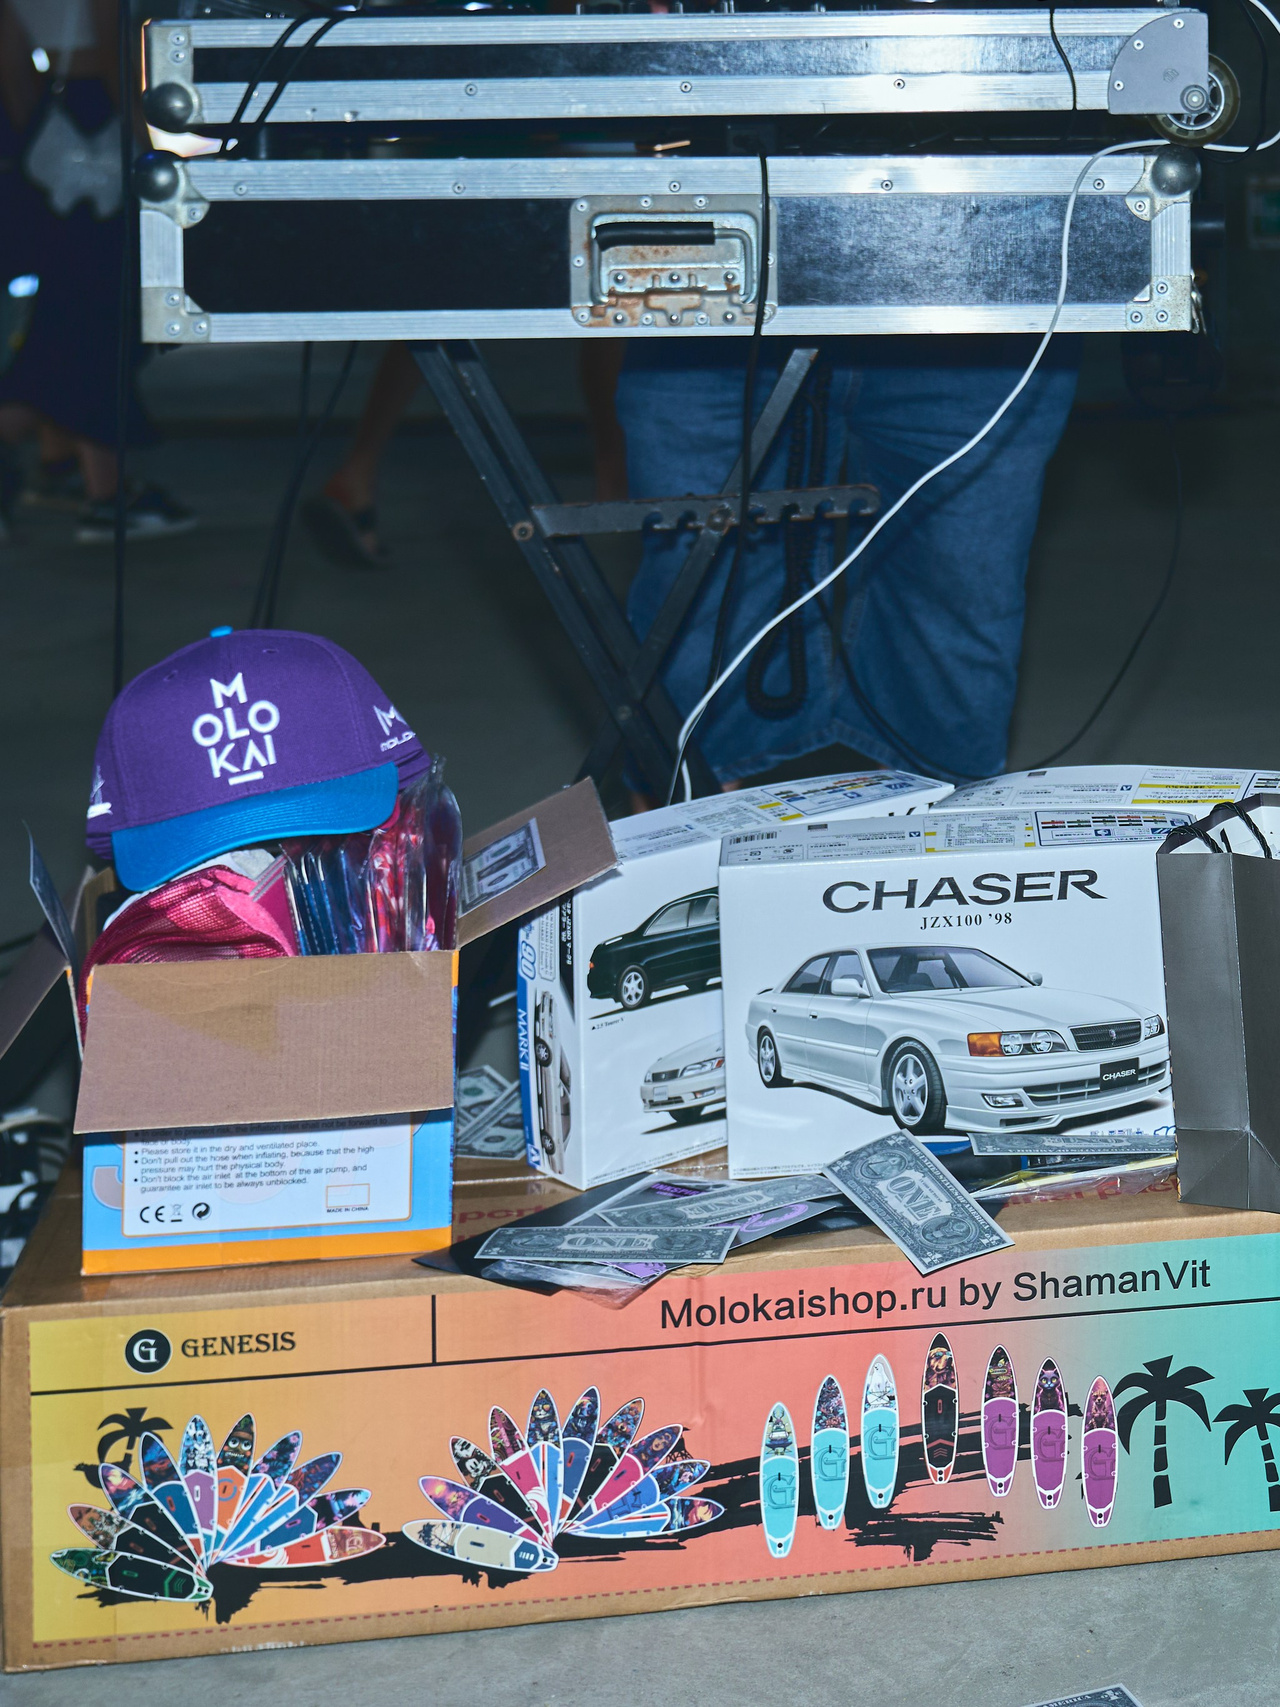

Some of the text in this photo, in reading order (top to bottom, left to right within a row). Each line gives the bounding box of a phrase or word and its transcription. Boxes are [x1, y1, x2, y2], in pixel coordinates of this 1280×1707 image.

[822, 869, 1107, 914] CHASER
[920, 914, 983, 930] JZX100
[517, 1008, 529, 1059] MARK
[1102, 1068, 1136, 1081] CHASER
[886, 1176, 942, 1222] ONE
[564, 1236, 653, 1246] ONE
[661, 1259, 1211, 1330] Molokaishop.ru by ShamanVit
[181, 1331, 296, 1358] GENESIS
